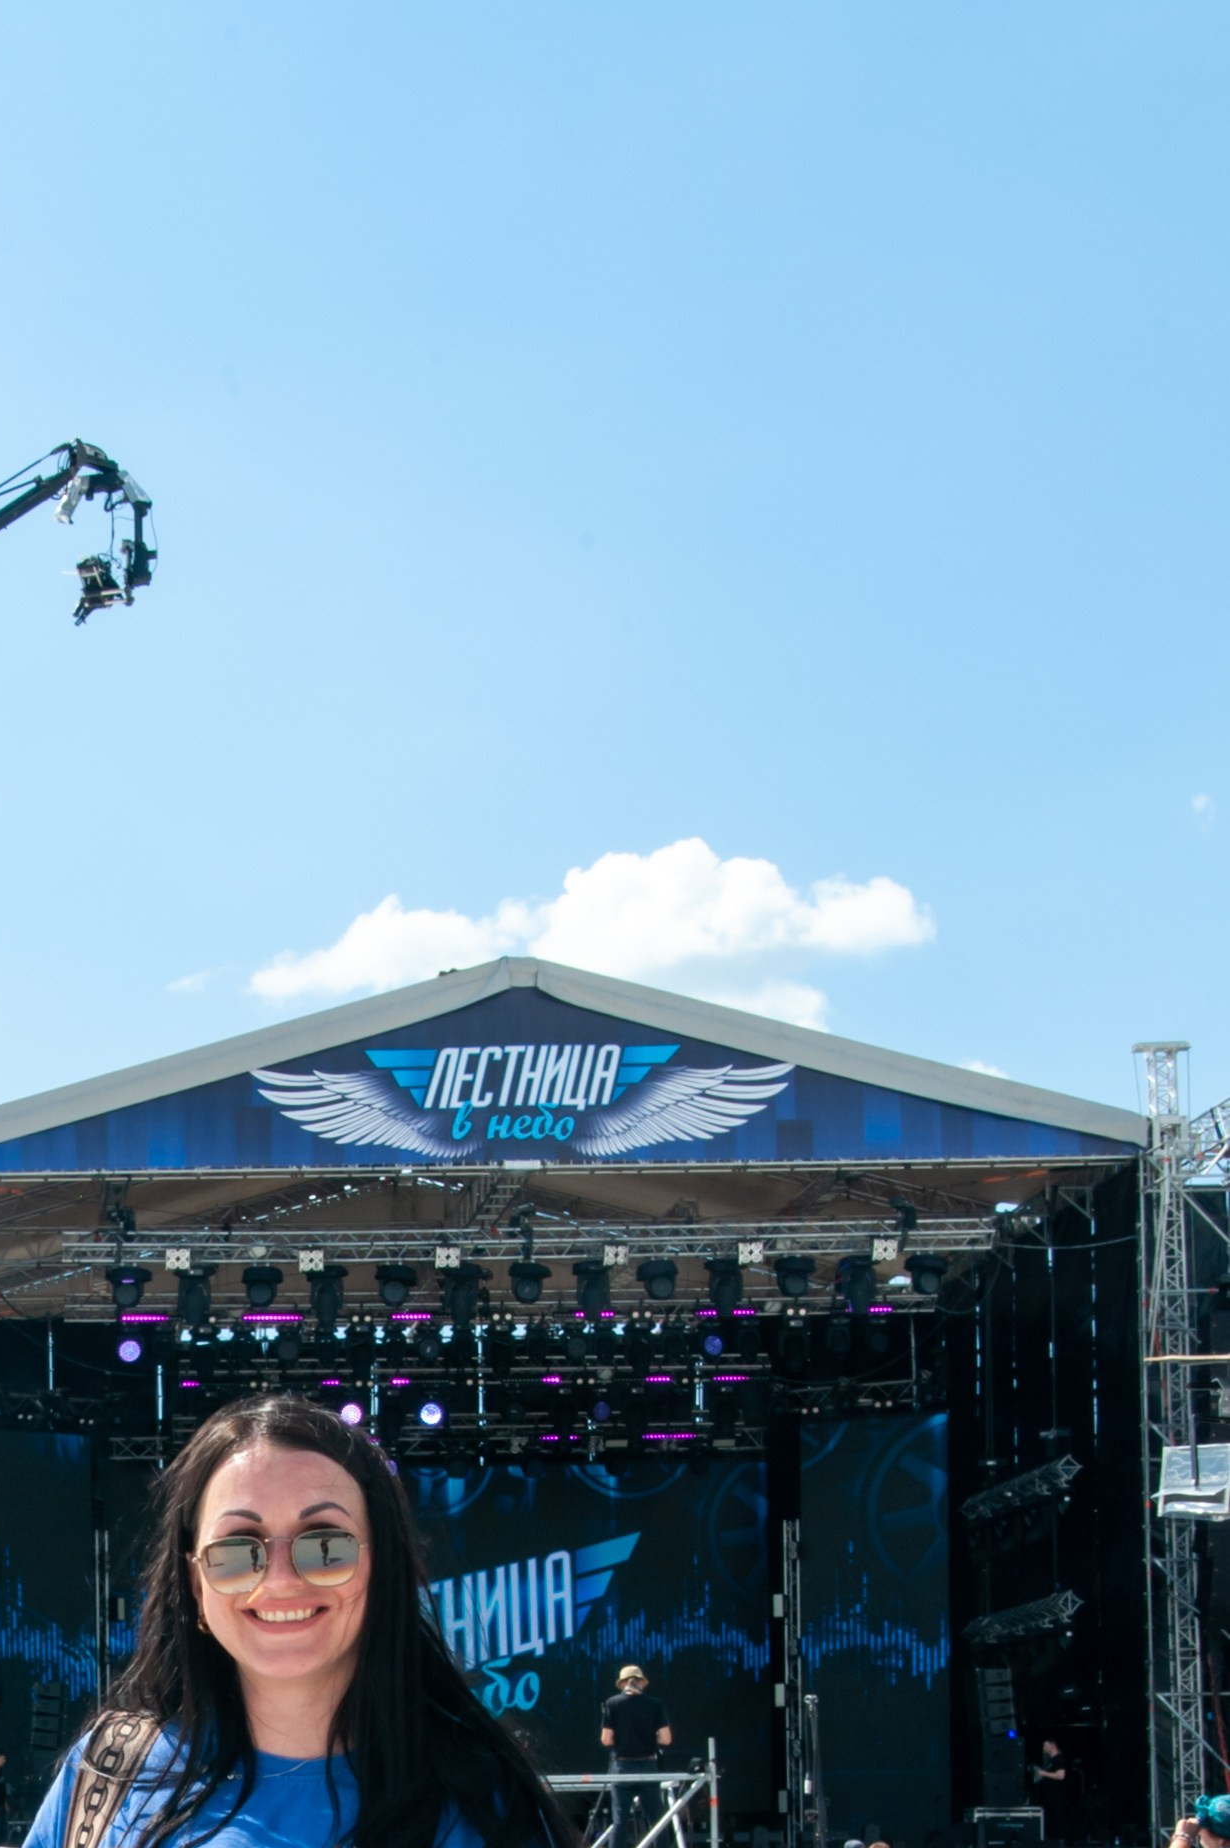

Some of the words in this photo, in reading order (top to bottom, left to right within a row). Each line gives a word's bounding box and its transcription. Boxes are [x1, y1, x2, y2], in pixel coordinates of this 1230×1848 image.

[423, 1044, 621, 1111] ЛЕСТНИЦА
[451, 1100, 474, 1140] в
[487, 1102, 575, 1141] небо
